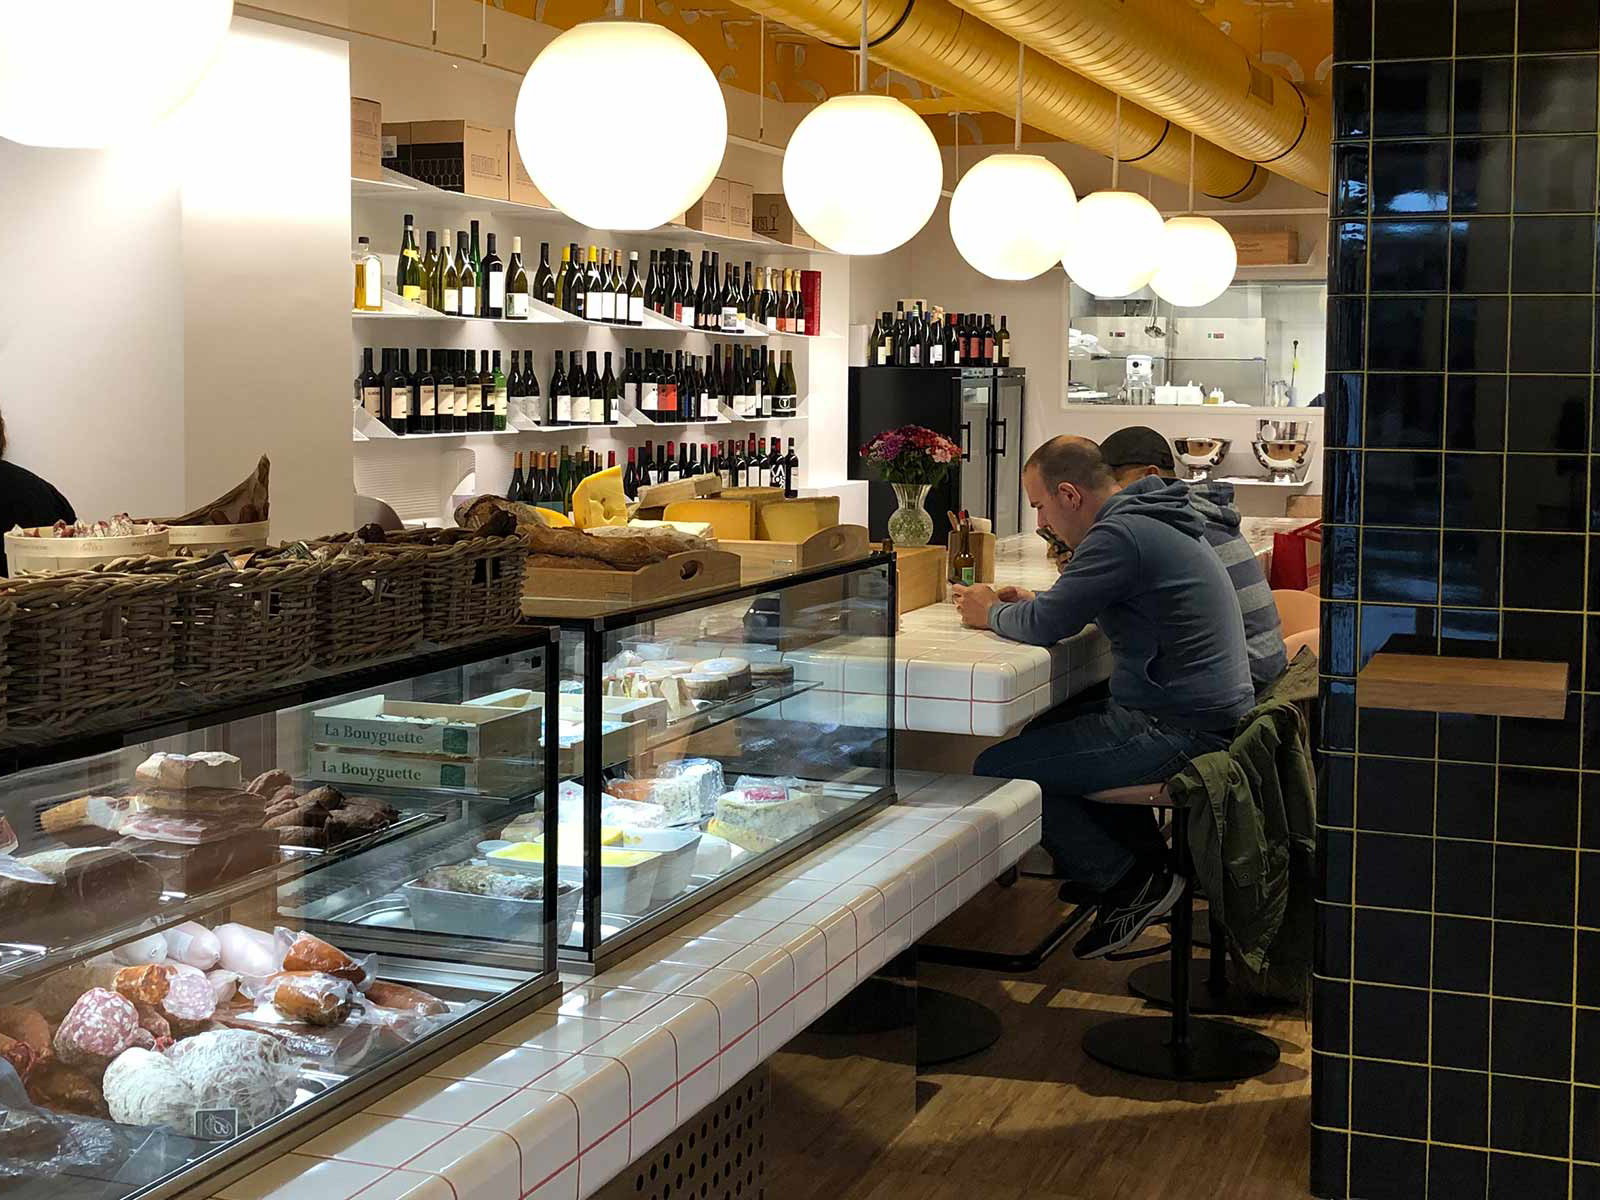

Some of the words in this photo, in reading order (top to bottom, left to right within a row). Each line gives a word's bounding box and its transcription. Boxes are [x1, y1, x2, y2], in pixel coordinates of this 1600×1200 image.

[325, 723, 339, 736] La
[344, 725, 424, 746] Bouyguette
[322, 760, 336, 773] La
[342, 761, 422, 781] Bouyguette
